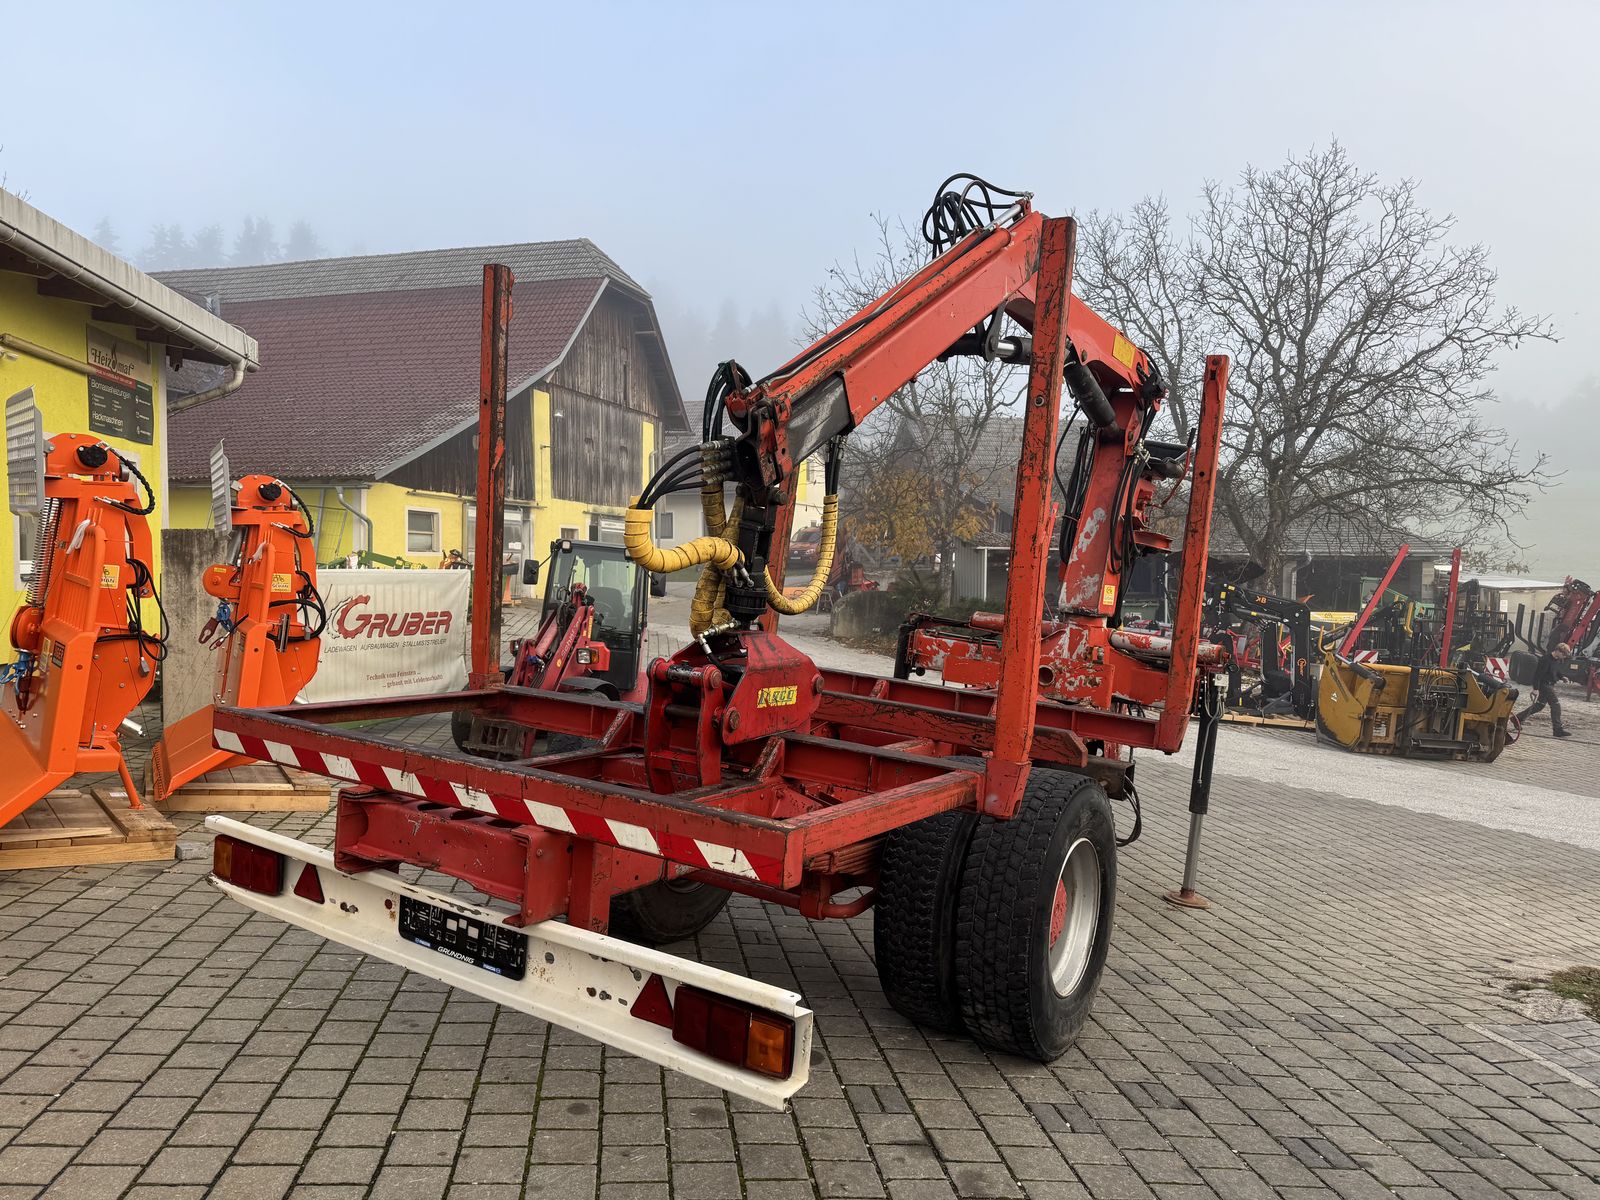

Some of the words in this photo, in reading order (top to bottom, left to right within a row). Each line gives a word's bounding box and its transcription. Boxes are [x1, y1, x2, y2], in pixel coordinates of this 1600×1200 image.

[92, 411, 124, 427] Hackmaschinen
[337, 595, 453, 639] GRUBER
[324, 644, 357, 654] LADEWAGEN
[360, 641, 399, 651] AUFBAUWAGEN
[402, 638, 447, 648] STALLMISTSTREUER
[366, 671, 387, 681] Technik
[437, 946, 475, 964] GRUNDNIG
